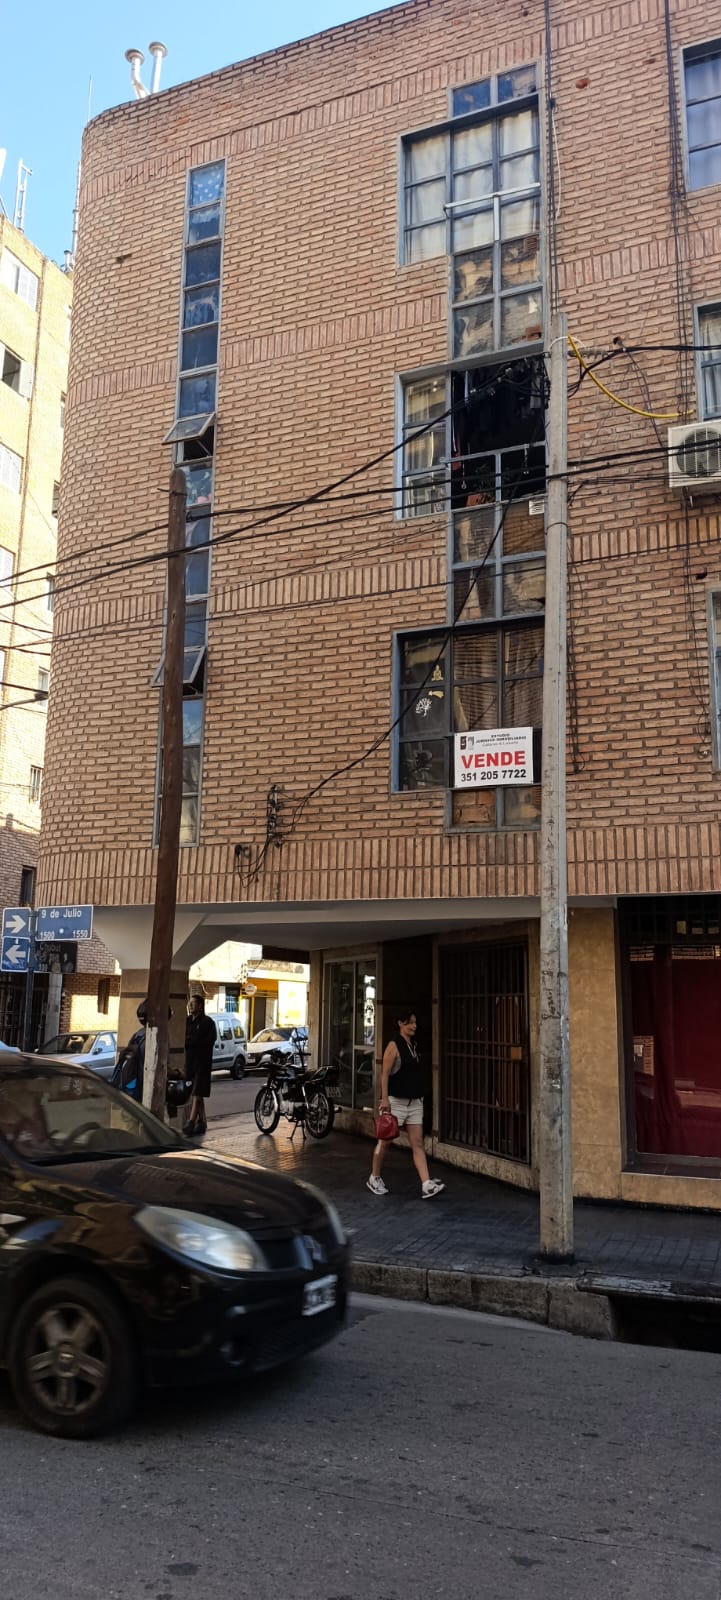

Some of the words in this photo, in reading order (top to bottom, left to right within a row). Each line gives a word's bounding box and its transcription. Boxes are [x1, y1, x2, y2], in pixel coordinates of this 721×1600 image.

[461, 750, 526, 769] VENDE
[461, 772, 477, 782] 351
[480, 770, 499, 781] 205
[501, 769, 527, 779] 7722
[41, 909, 47, 919] 9
[50, 909, 60, 918] de
[63, 908, 82, 918] Julio
[40, 931, 55, 940] 1500
[72, 929, 88, 938] 1550
